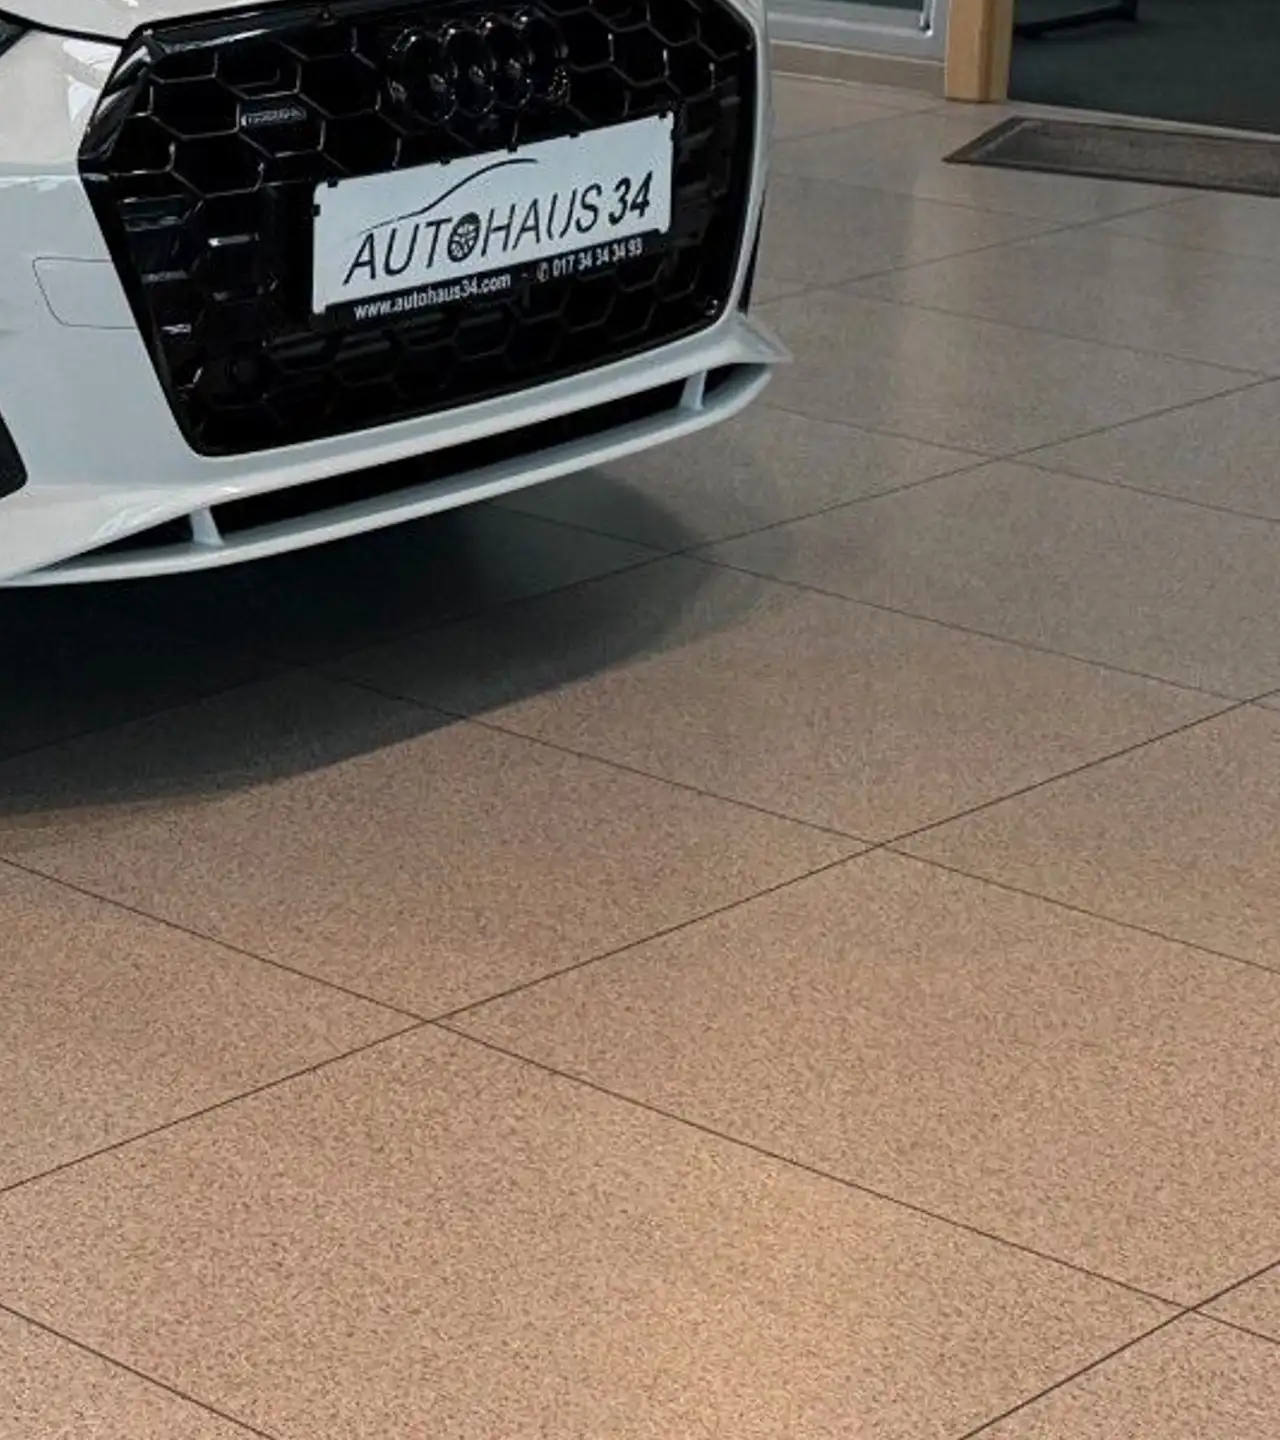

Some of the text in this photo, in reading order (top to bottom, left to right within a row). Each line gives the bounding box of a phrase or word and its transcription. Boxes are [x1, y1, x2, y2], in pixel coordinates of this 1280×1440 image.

[343, 170, 653, 286] AUTOHAUS 34
[354, 272, 512, 320] www.autohaus34.com
[552, 254, 575, 278] 017
[578, 250, 593, 270] 34
[595, 245, 609, 266] 34
